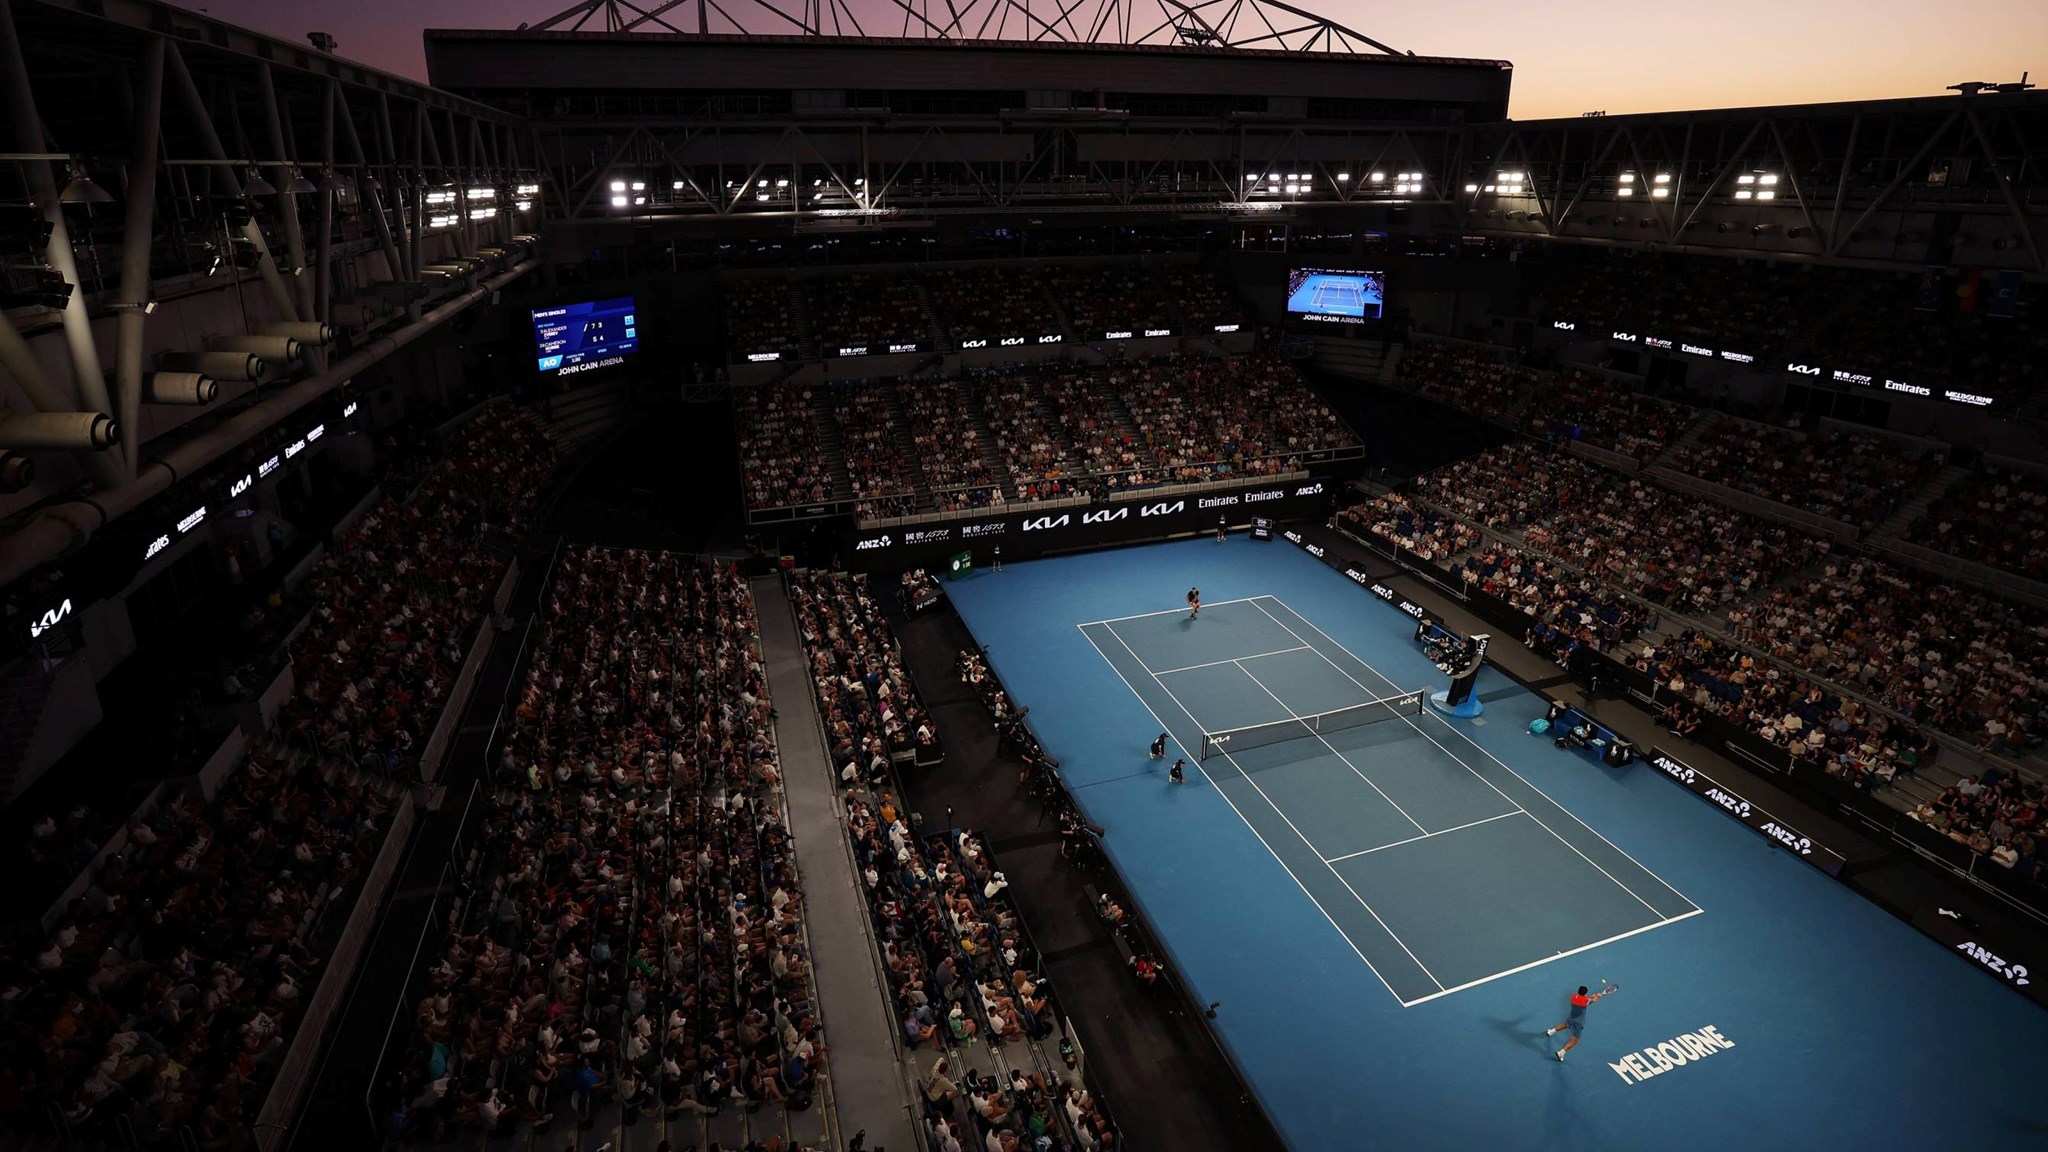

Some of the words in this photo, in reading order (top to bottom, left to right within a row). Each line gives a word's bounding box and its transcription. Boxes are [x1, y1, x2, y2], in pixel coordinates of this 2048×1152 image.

[1106, 331, 1132, 339] Emirates
[1145, 329, 1170, 337] Emirates
[1681, 344, 1713, 357] Emirates
[558, 365, 579, 376] JOHN
[580, 361, 598, 372] CAIN
[599, 356, 624, 367] ARENA
[1884, 379, 1931, 396] Emirates
[1245, 490, 1284, 503] Emirates
[1296, 486, 1314, 497] ANZ
[1198, 495, 1239, 509] Emirates
[1284, 531, 1297, 541] ANZ
[856, 539, 880, 550] ANZ
[1306, 544, 1319, 555] ANZ
[1345, 568, 1361, 580] ANZ
[1371, 584, 1387, 596] ANZ
[1399, 601, 1416, 614] ANZ
[1653, 757, 1683, 777] ANZ
[1705, 788, 1737, 810] ANZ
[1760, 822, 1797, 847] ANZ
[1957, 941, 2007, 973] ANZ
[1607, 1024, 1736, 1085] MELBOURNE
